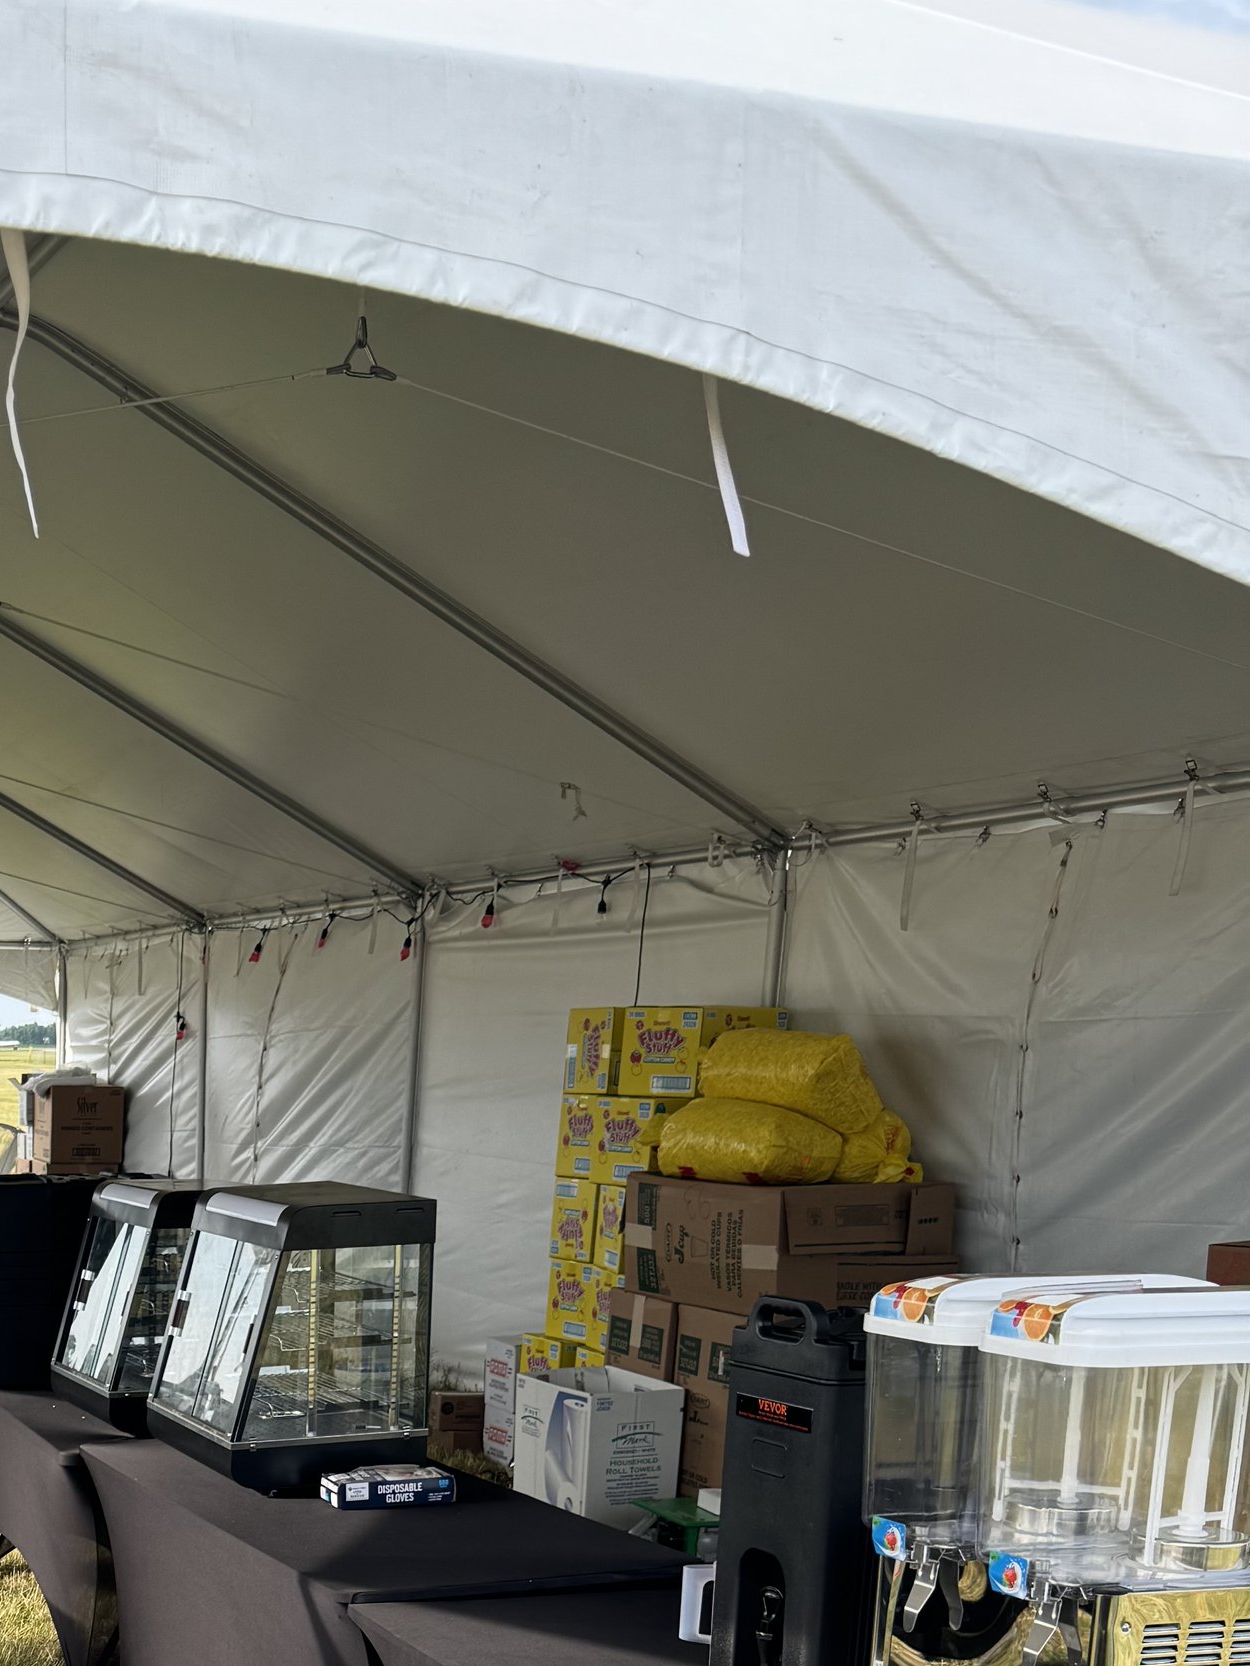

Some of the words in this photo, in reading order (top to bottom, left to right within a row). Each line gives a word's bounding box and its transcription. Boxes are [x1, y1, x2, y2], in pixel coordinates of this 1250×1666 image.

[637, 1027, 686, 1049] Fluffy
[645, 1042, 673, 1055] Stuff
[605, 1118, 642, 1138] Fluffy
[610, 1132, 631, 1143] Stuff
[674, 1225, 689, 1264] Jcup
[758, 1399, 787, 1416] VEVOR
[621, 1423, 651, 1432] FIRST
[622, 1434, 650, 1446] Mark
[609, 1457, 659, 1467] HOUSEHOLD
[605, 1467, 627, 1476] ROLL
[630, 1465, 662, 1475] TOWELS
[377, 1482, 423, 1494] DISPOSABLE
[385, 1492, 415, 1503] GLOVES
